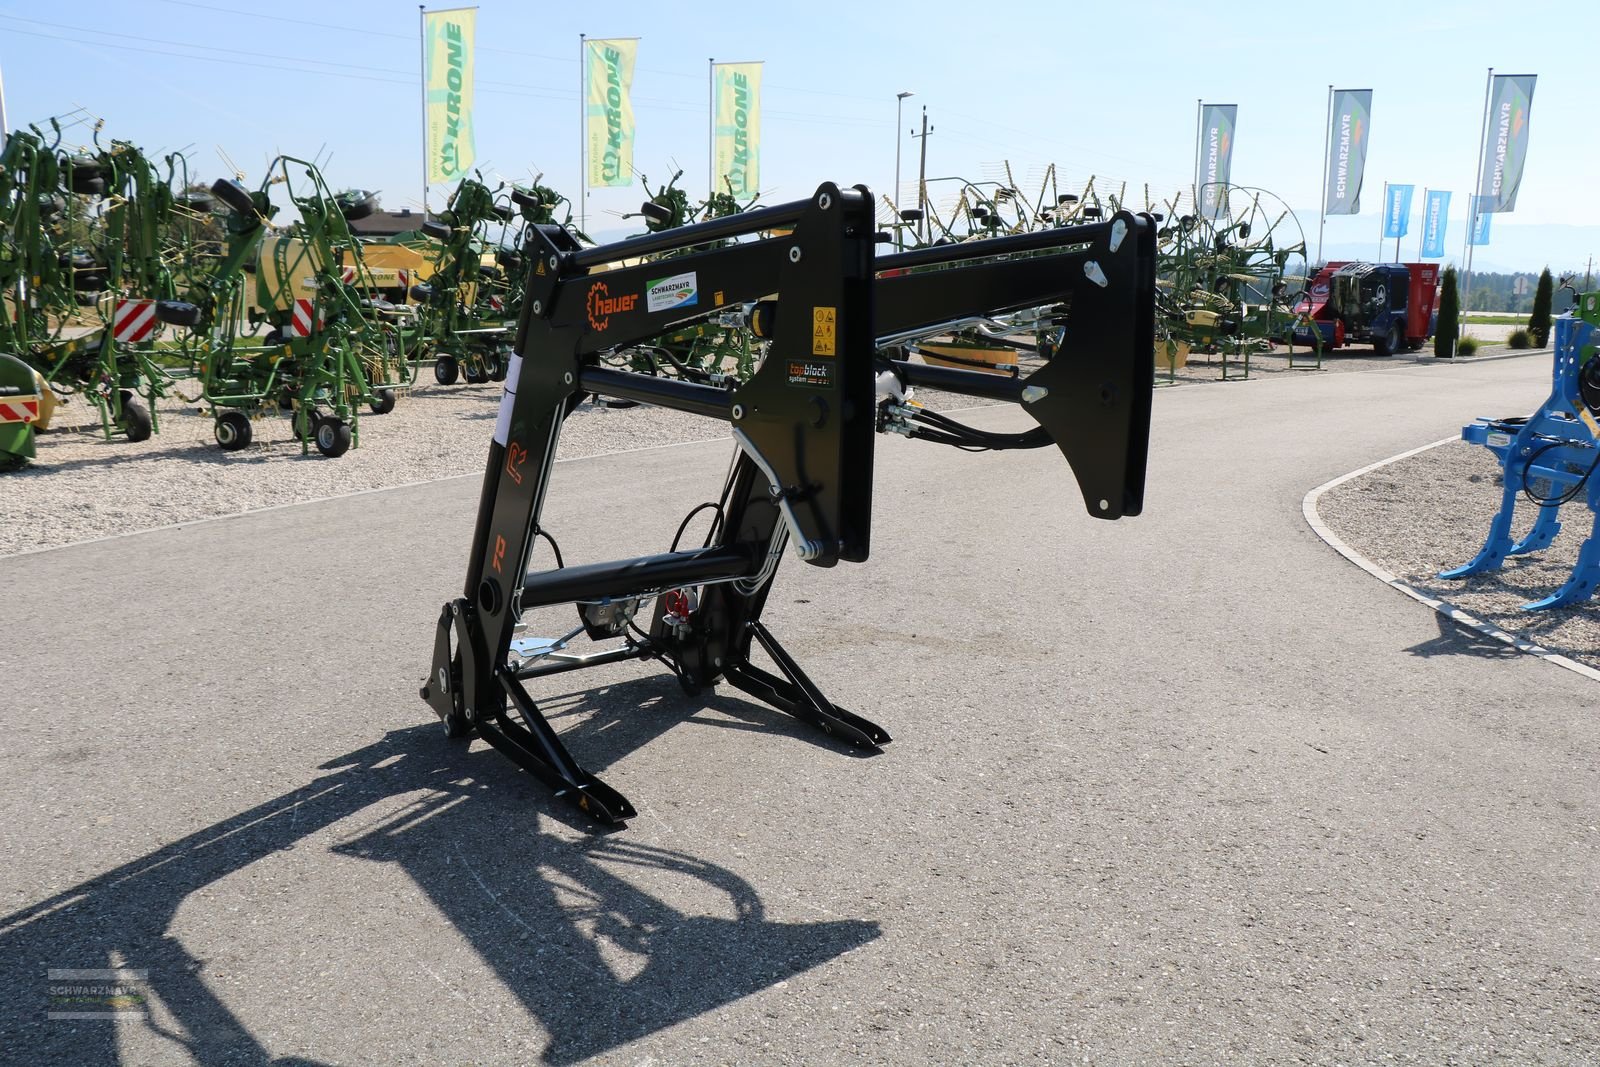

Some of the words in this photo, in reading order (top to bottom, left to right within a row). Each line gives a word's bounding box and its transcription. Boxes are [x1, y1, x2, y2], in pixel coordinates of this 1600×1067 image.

[446, 22, 462, 139] KRONE
[604, 47, 622, 150] KRONE
[733, 72, 748, 166] KRONE
[1206, 127, 1219, 205] SCHWARZMAYR
[1337, 114, 1351, 199] SCHWARZMAYR
[1491, 102, 1511, 196] SCHWARZMAYR
[595, 293, 639, 316] hauer
[651, 281, 690, 295] SCHWARZMAYR
[788, 375, 807, 383] system
[492, 534, 507, 573] 70
